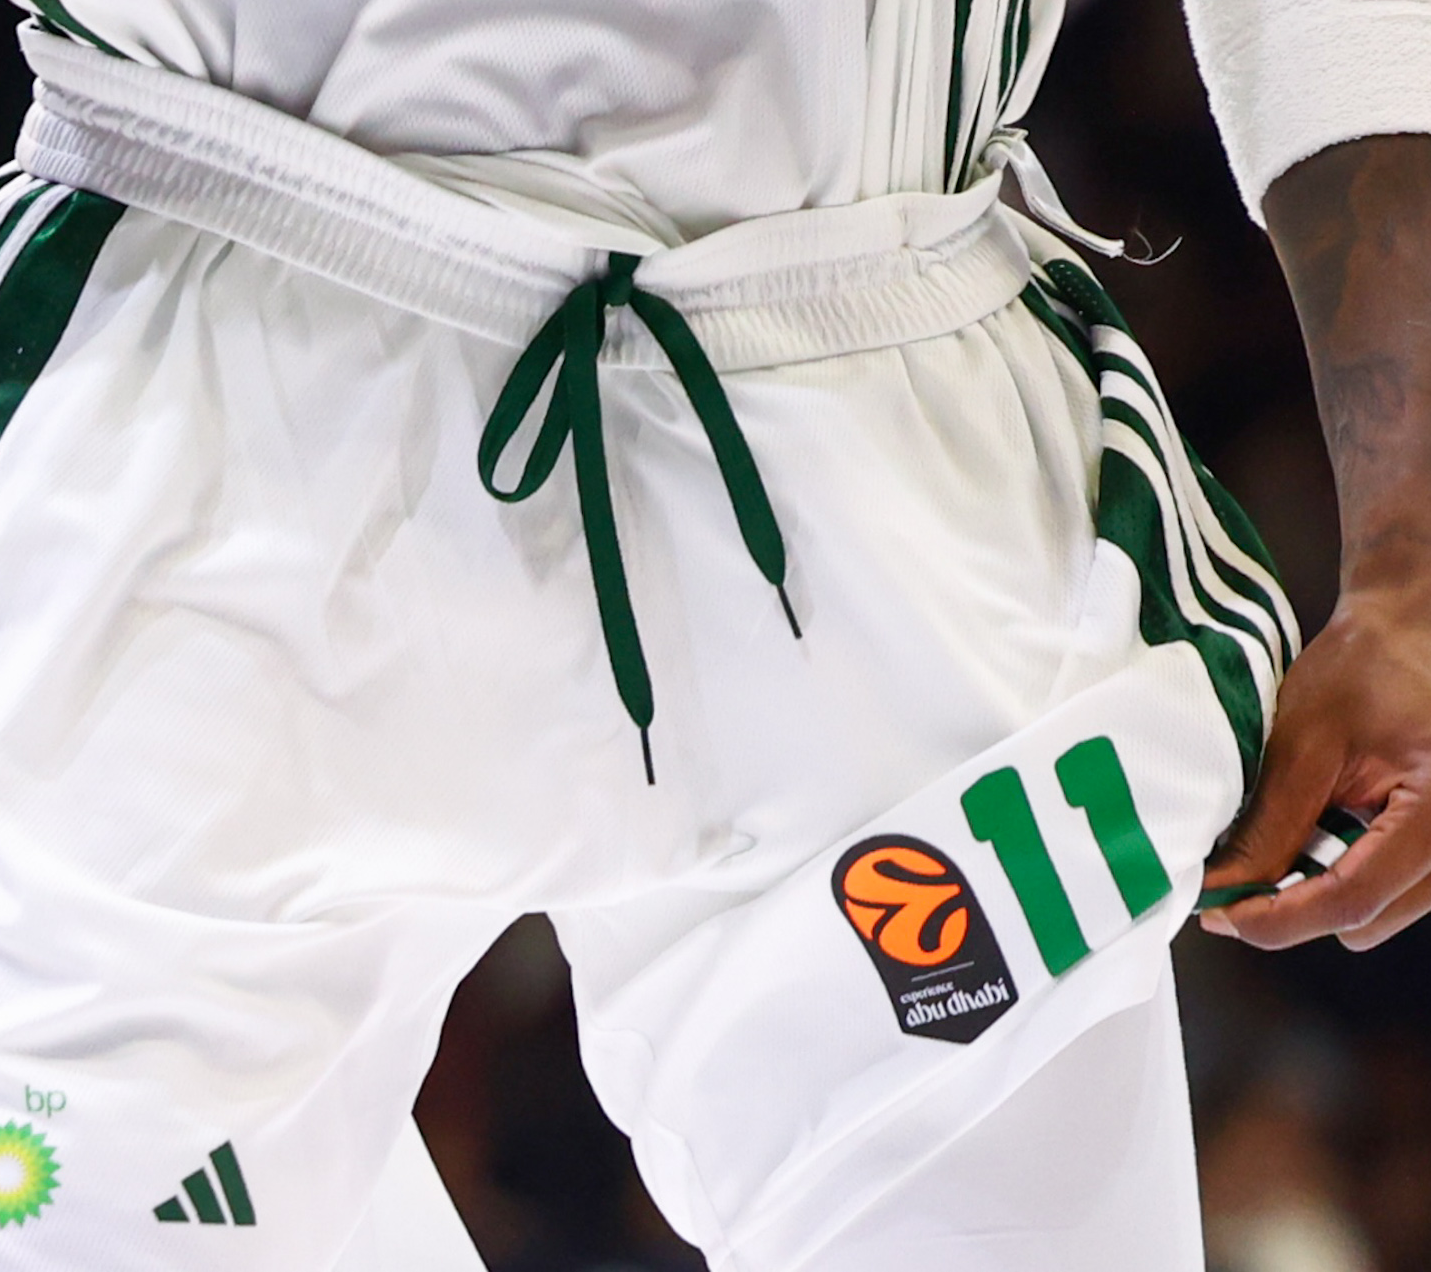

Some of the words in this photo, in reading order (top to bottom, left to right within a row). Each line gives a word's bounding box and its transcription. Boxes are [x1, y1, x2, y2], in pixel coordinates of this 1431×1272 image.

[960, 735, 1173, 978] 11
[899, 981, 954, 1004] experience
[906, 1000, 947, 1027] abu
[948, 978, 1009, 1015] dhabi
[24, 1084, 67, 1119] bp
